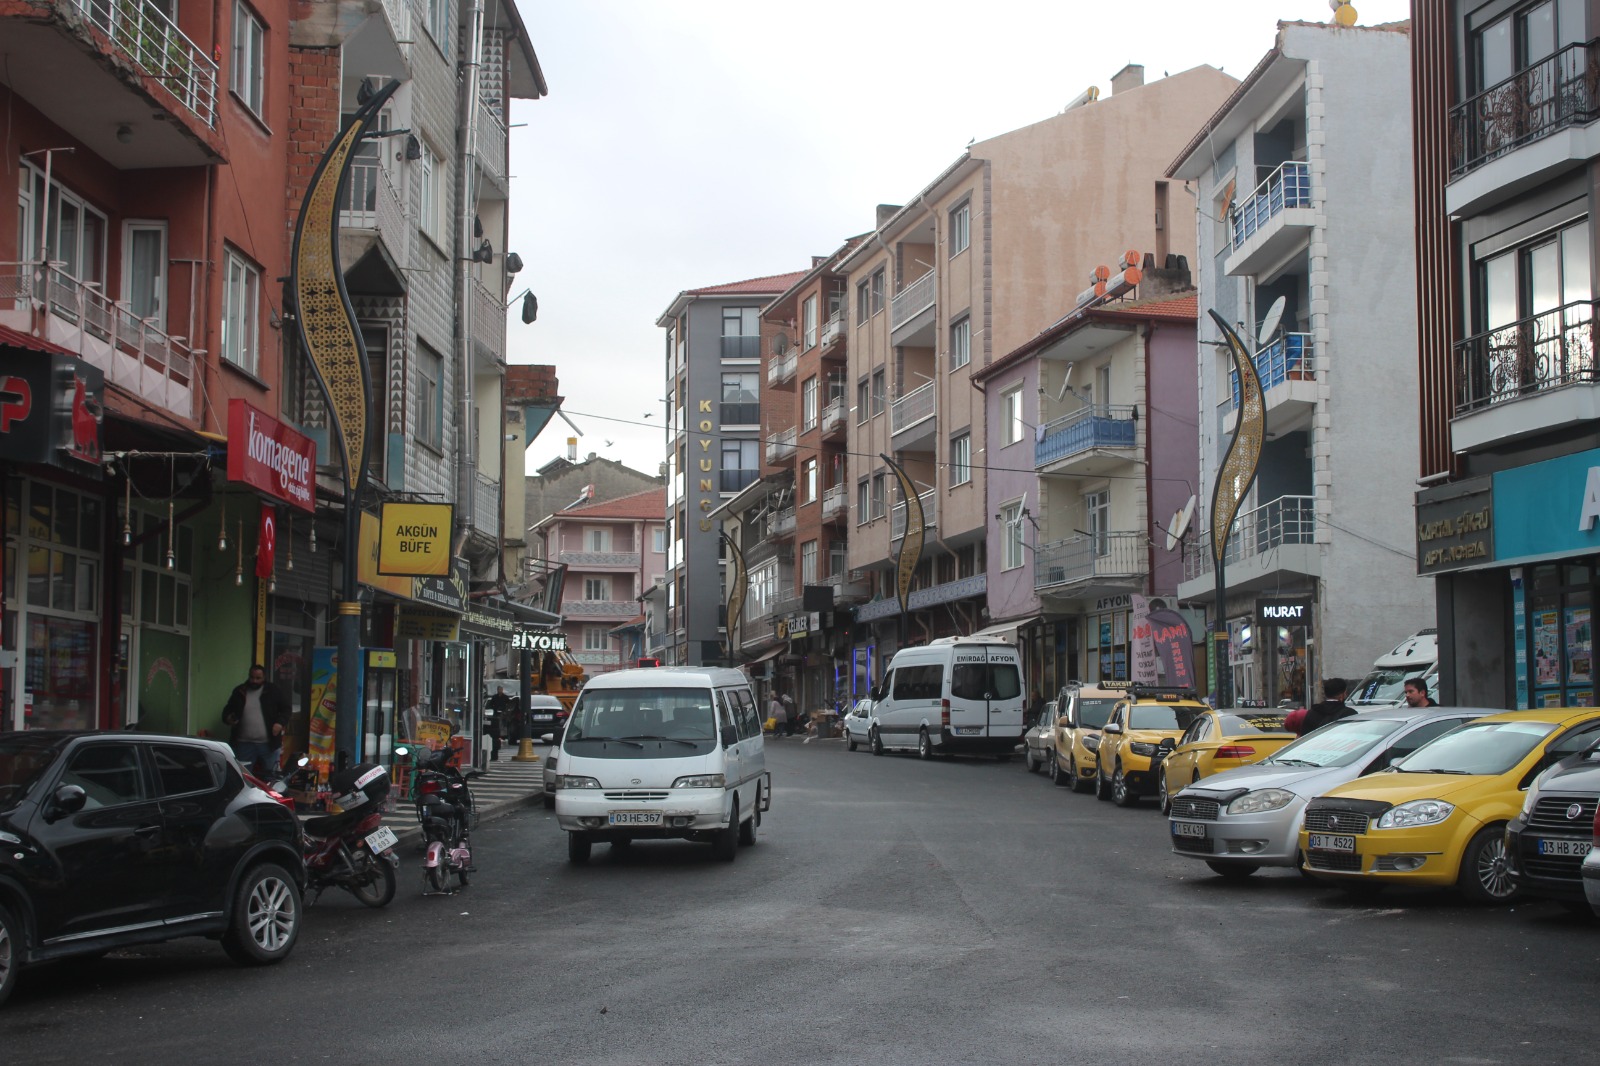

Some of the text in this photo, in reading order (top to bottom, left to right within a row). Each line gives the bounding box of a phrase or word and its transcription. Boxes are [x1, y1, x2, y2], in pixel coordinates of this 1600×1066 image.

[248, 411, 309, 488] komagene
[699, 400, 712, 533] KOYUNCU
[396, 523, 438, 538] AKGÜN
[1419, 519, 1454, 542] KARTAL
[400, 538, 432, 553] BÜFE
[1096, 594, 1130, 610] AFYON
[1263, 605, 1304, 618] MURAT
[956, 654, 985, 662] EMİRDAĞ
[616, 813, 627, 823] 03
[1183, 824, 1192, 834] EK
[1192, 825, 1203, 835] 430
[1312, 835, 1353, 849] 03 T 4522
[1543, 841, 1592, 855] 03 HB 282
